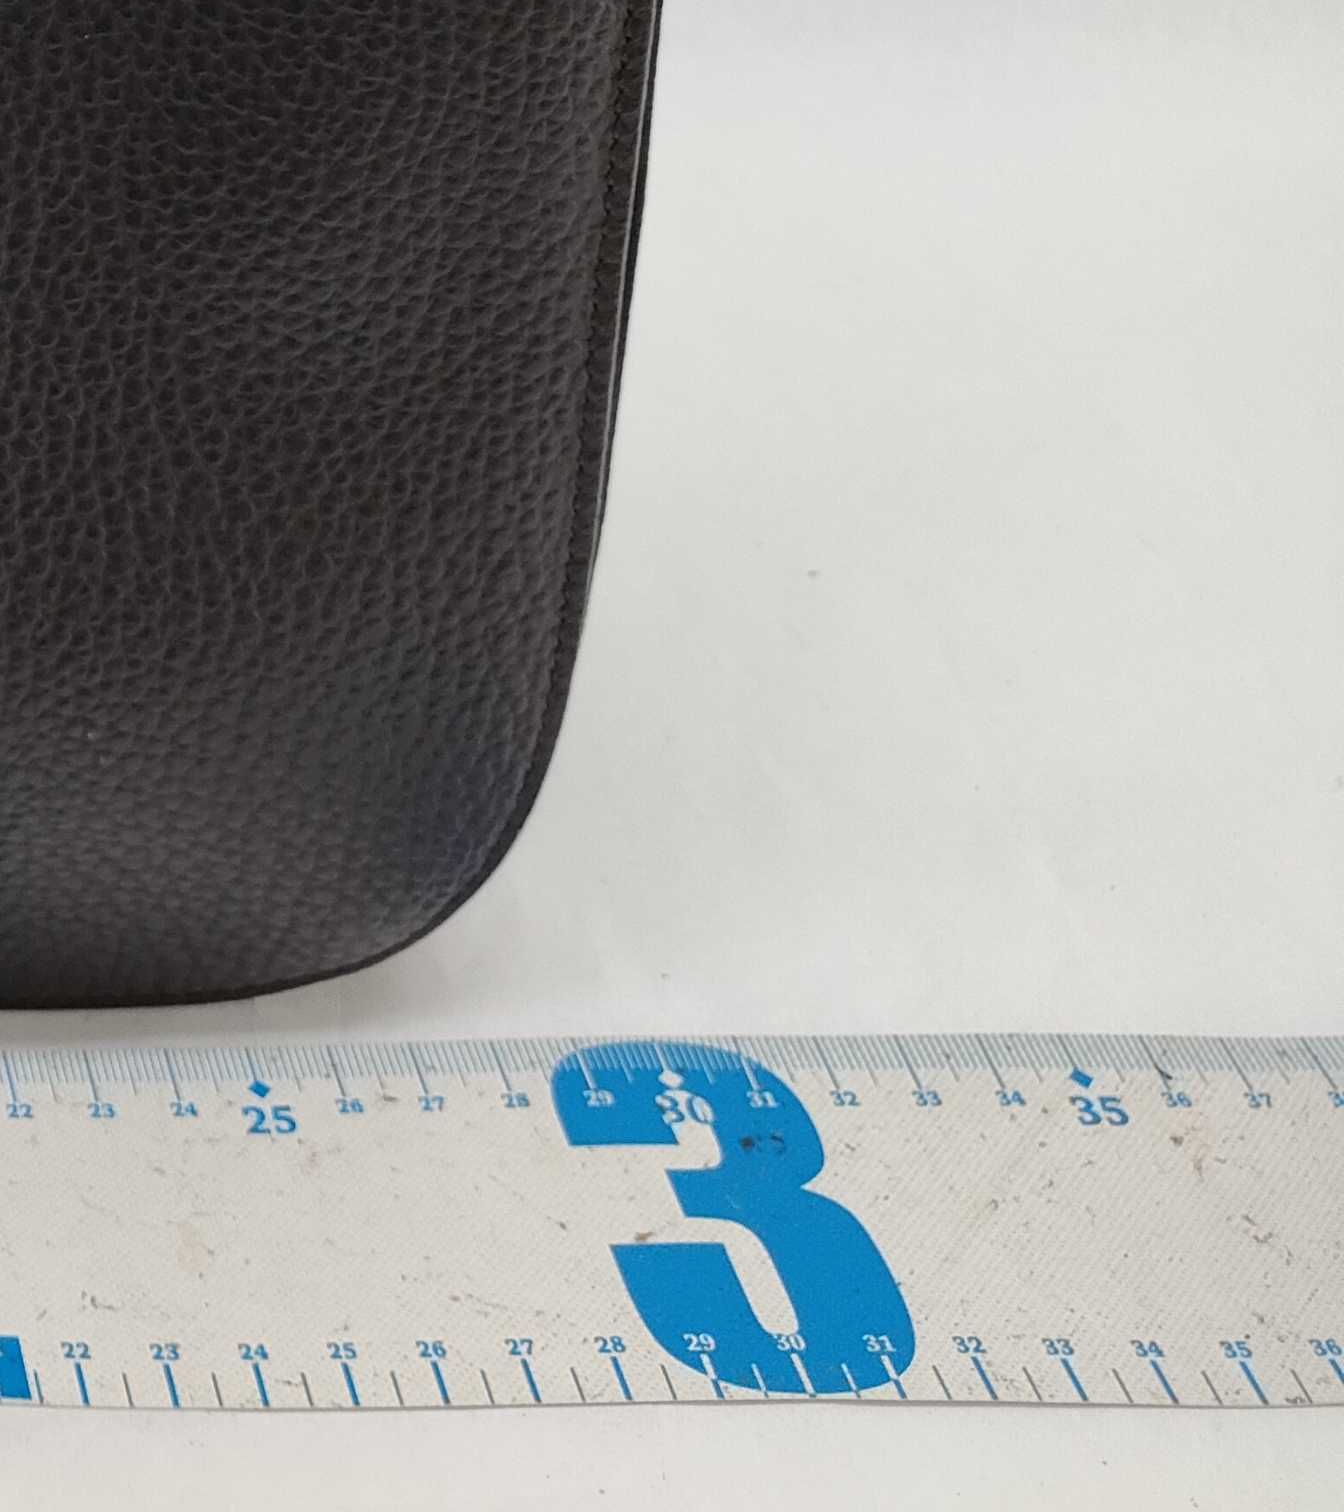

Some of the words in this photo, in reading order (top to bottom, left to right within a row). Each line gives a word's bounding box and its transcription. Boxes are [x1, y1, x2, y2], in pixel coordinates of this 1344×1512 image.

[8, 1103, 33, 1118] 22
[88, 1102, 115, 1118] 23
[170, 1101, 198, 1117] 24
[242, 1104, 297, 1135] 25
[335, 1097, 363, 1114] 26
[418, 1095, 444, 1112] 27
[501, 1092, 529, 1108] 28
[655, 1089, 715, 1123] 30
[746, 1090, 778, 1108] 31
[829, 1090, 859, 1107] 32
[912, 1090, 942, 1107] 33
[995, 1090, 1026, 1107] 34
[1069, 1095, 1129, 1126] 35
[1244, 1092, 1272, 1107] 37
[551, 1042, 915, 1394] 3
[61, 1342, 91, 1360] 22
[150, 1343, 180, 1361] 23
[238, 1343, 269, 1361] 24
[327, 1342, 357, 1360] 25
[416, 1340, 447, 1358] 26
[505, 1338, 534, 1356] 27
[595, 1336, 626, 1354] 28
[683, 1333, 716, 1351] 29
[776, 1333, 806, 1351] 30
[863, 1334, 895, 1352] 31
[953, 1336, 986, 1354] 32
[1042, 1338, 1073, 1356] 33
[1131, 1340, 1164, 1357] 34
[1220, 1341, 1252, 1358] 35
[1308, 1338, 1342, 1356] 36
